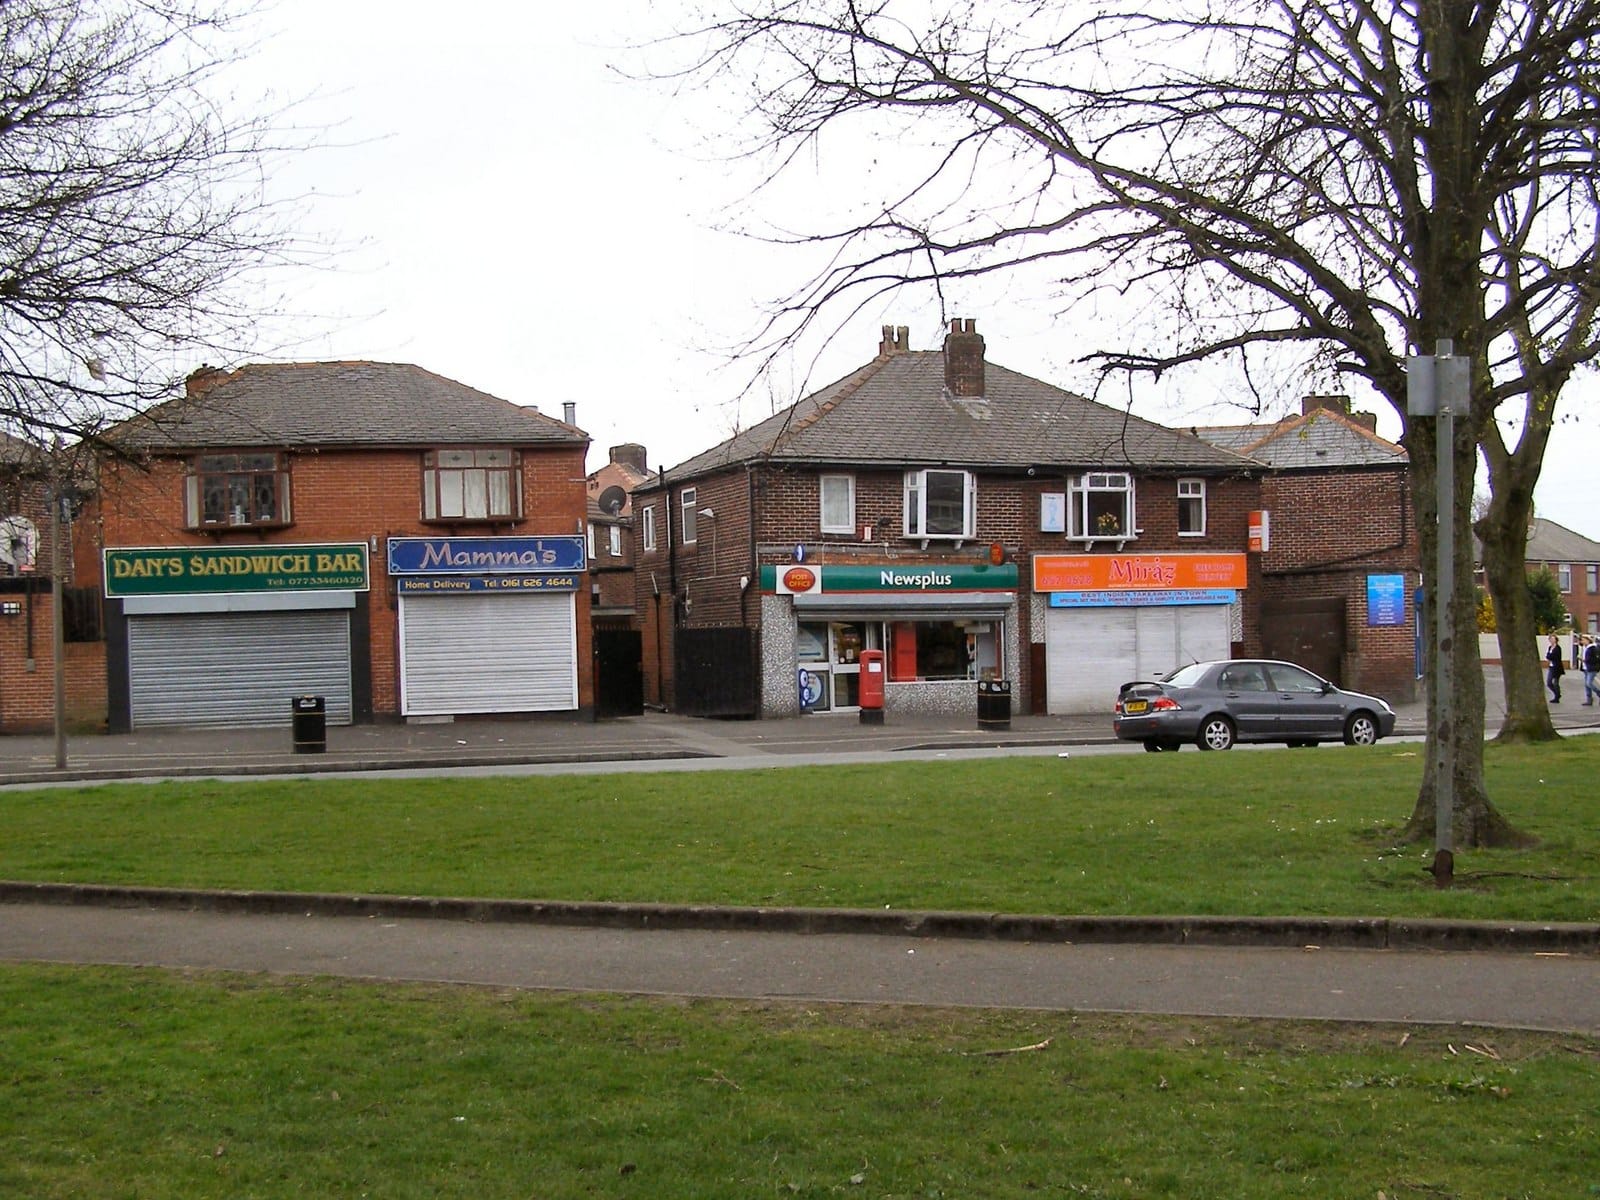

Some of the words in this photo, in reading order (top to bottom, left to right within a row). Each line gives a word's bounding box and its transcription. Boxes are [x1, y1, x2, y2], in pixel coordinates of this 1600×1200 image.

[114, 557, 185, 578] DAN'S
[190, 554, 312, 576] SANDWICH
[316, 553, 363, 573] BAR
[420, 541, 557, 570] Mamma's
[405, 580, 430, 589] Home
[433, 580, 471, 590] Delivery
[483, 579, 497, 588] Tel
[502, 579, 520, 587] 0161
[523, 578, 542, 587] 626
[546, 578, 573, 586] 4644
[880, 570, 952, 590] Newsplus
